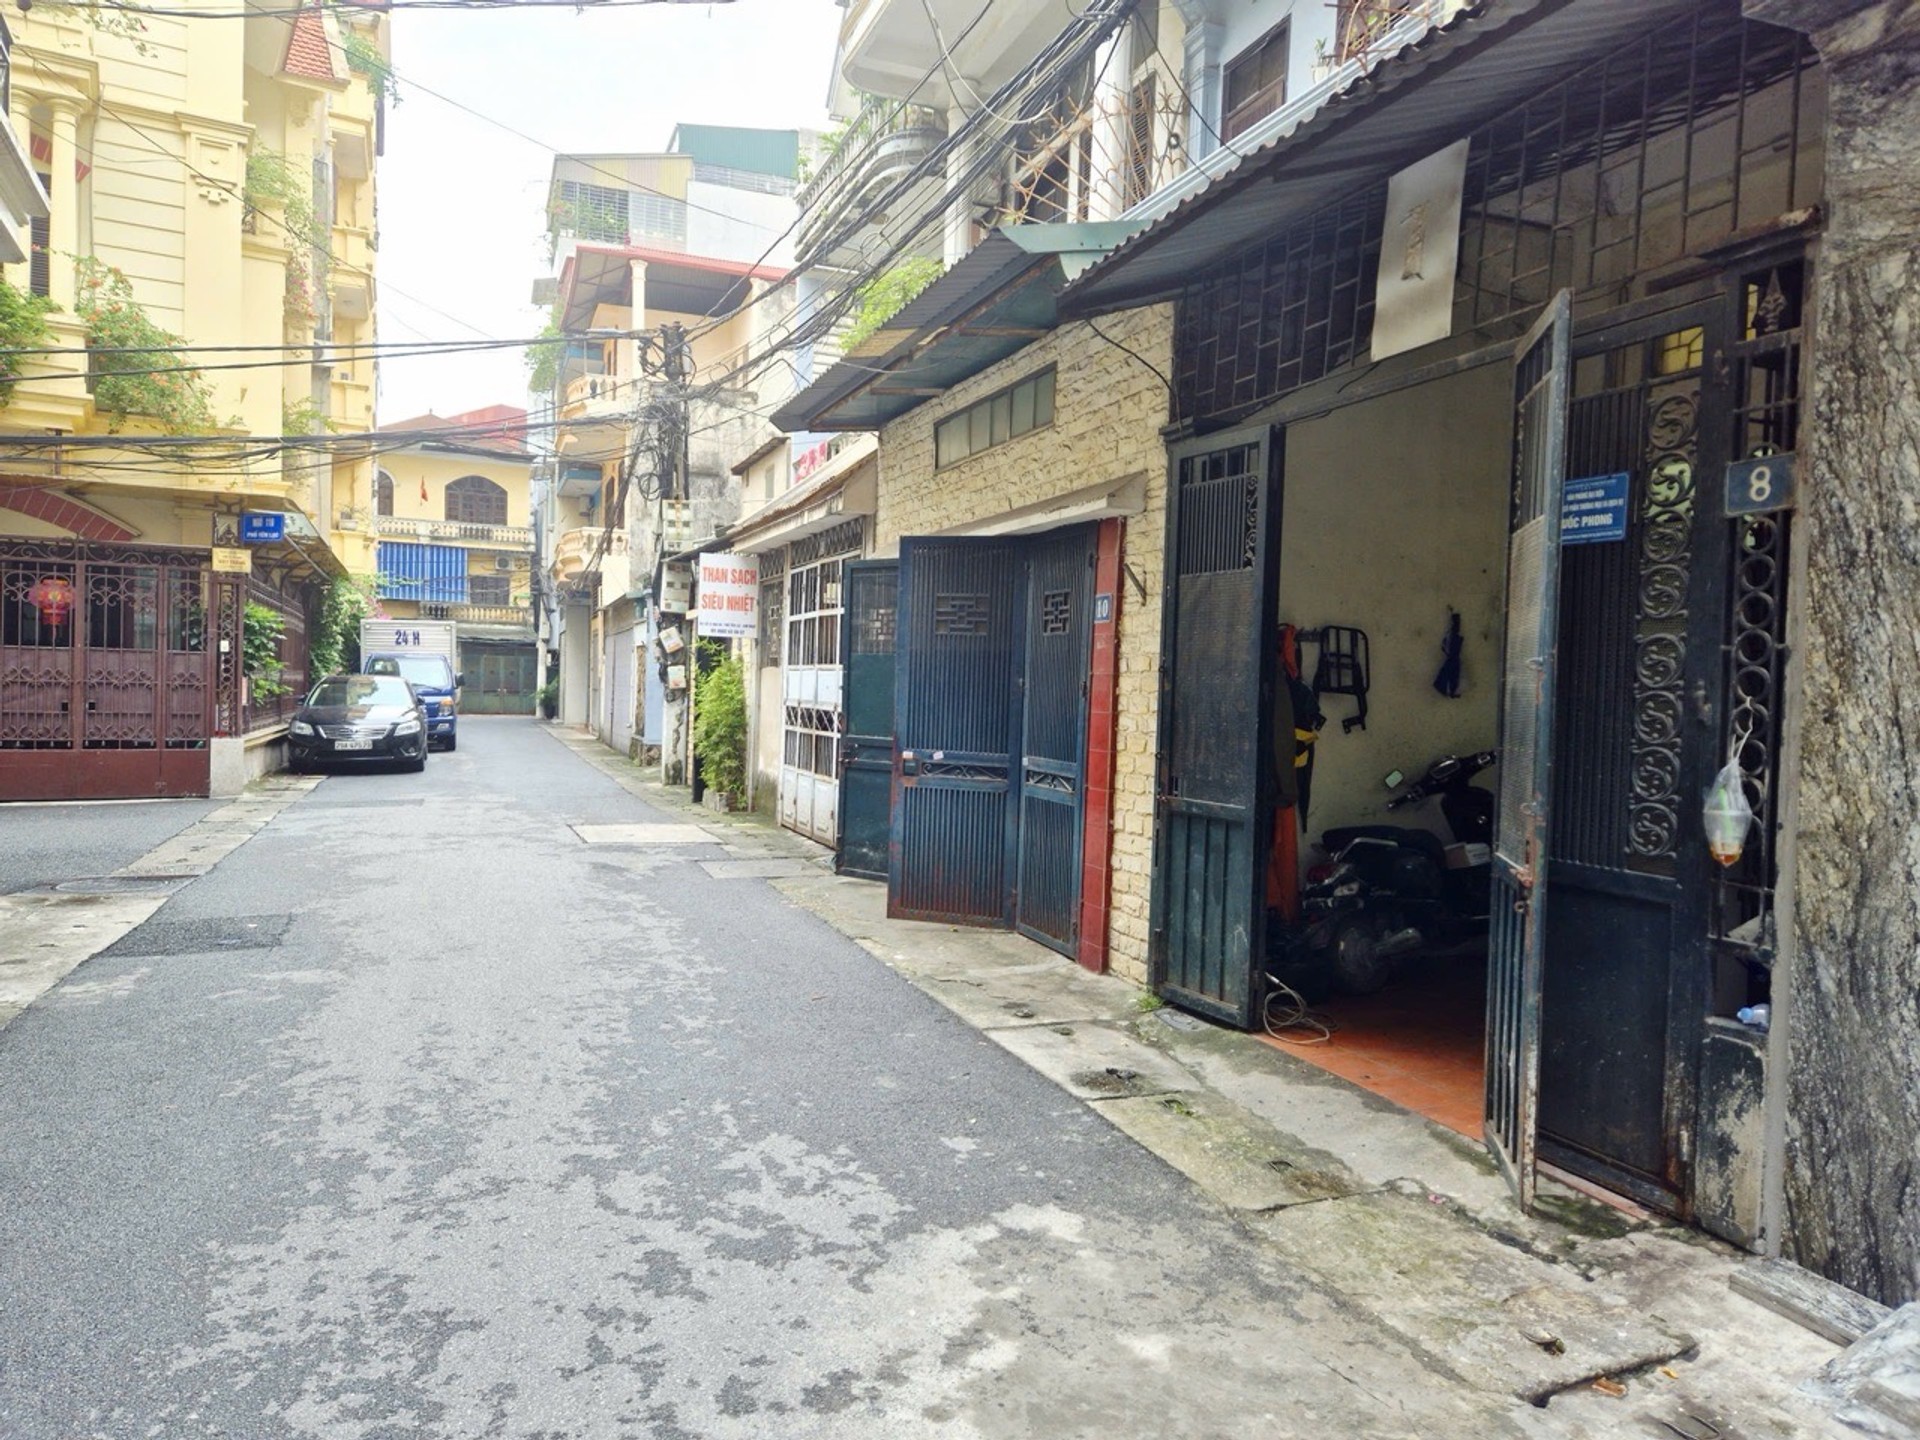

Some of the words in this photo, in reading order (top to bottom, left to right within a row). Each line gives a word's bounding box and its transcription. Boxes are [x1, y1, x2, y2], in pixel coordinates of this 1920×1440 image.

[1749, 465, 1771, 502] 8
[1561, 514, 1580, 529] UỐC
[1581, 512, 1613, 528] PHONG
[702, 566, 729, 584] THAN
[730, 568, 758, 588] SẠCH
[702, 591, 724, 610] SIÊU
[727, 593, 756, 616] NHIỆT
[1096, 599, 1109, 618] 10
[395, 629, 408, 645] 24
[412, 631, 420, 646] H
